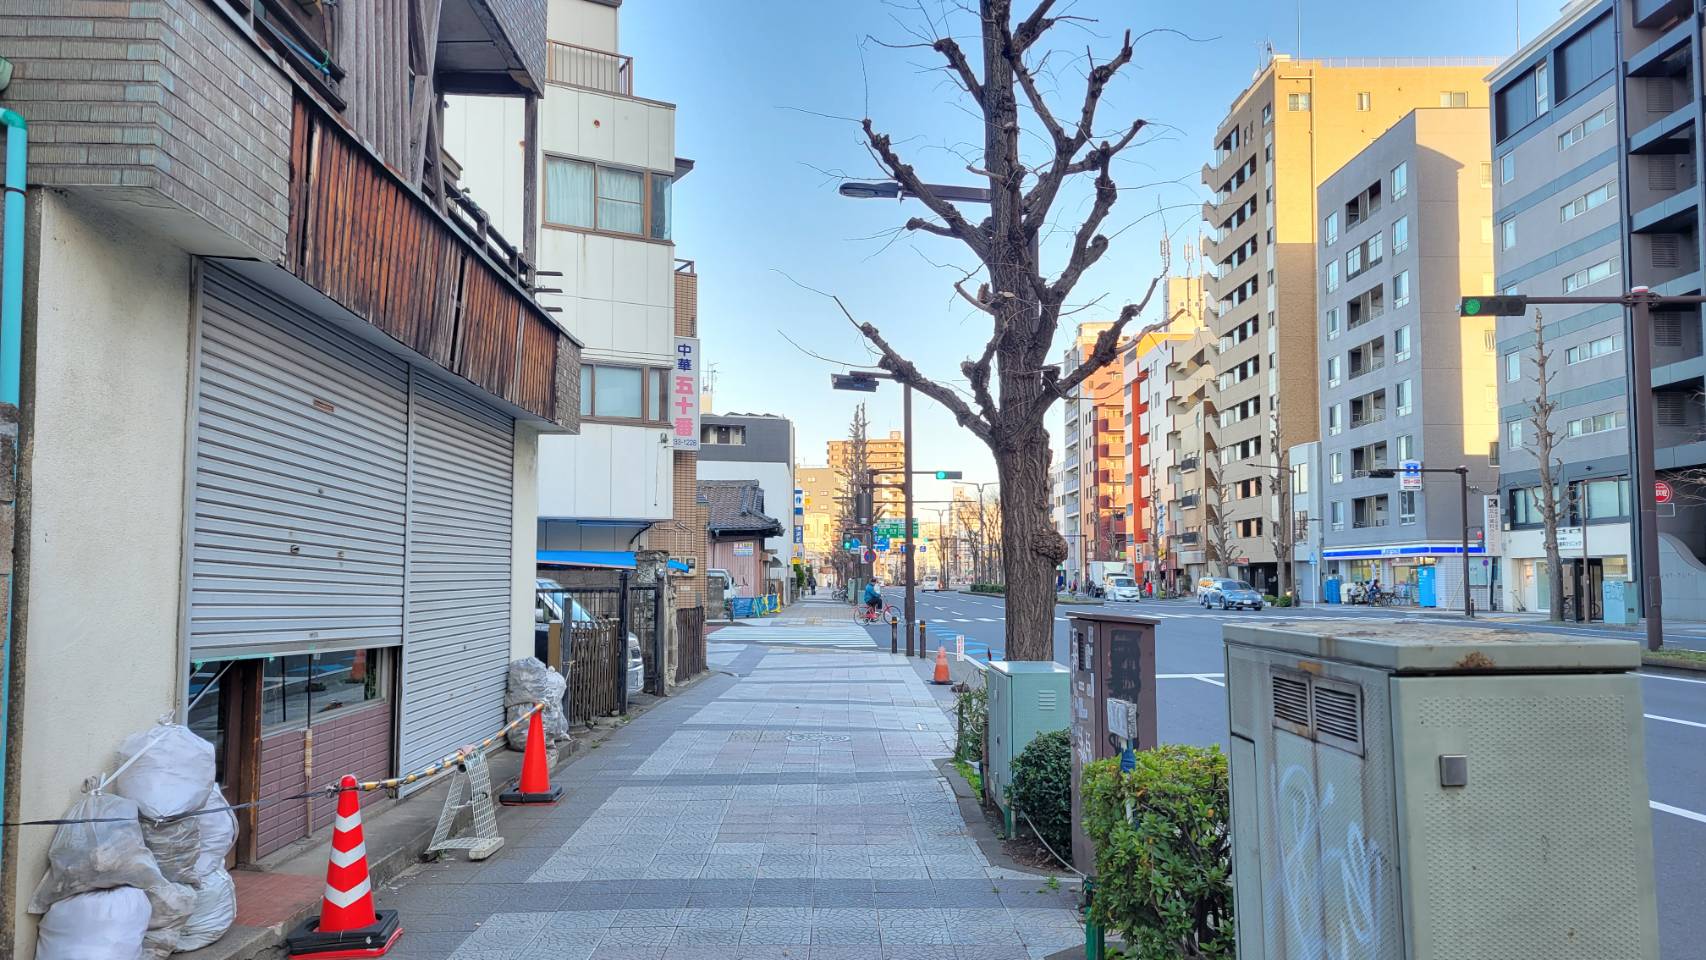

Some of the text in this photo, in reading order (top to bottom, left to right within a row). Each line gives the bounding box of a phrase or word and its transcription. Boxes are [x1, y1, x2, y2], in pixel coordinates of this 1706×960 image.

[674, 343, 694, 437] 中華 五十番
